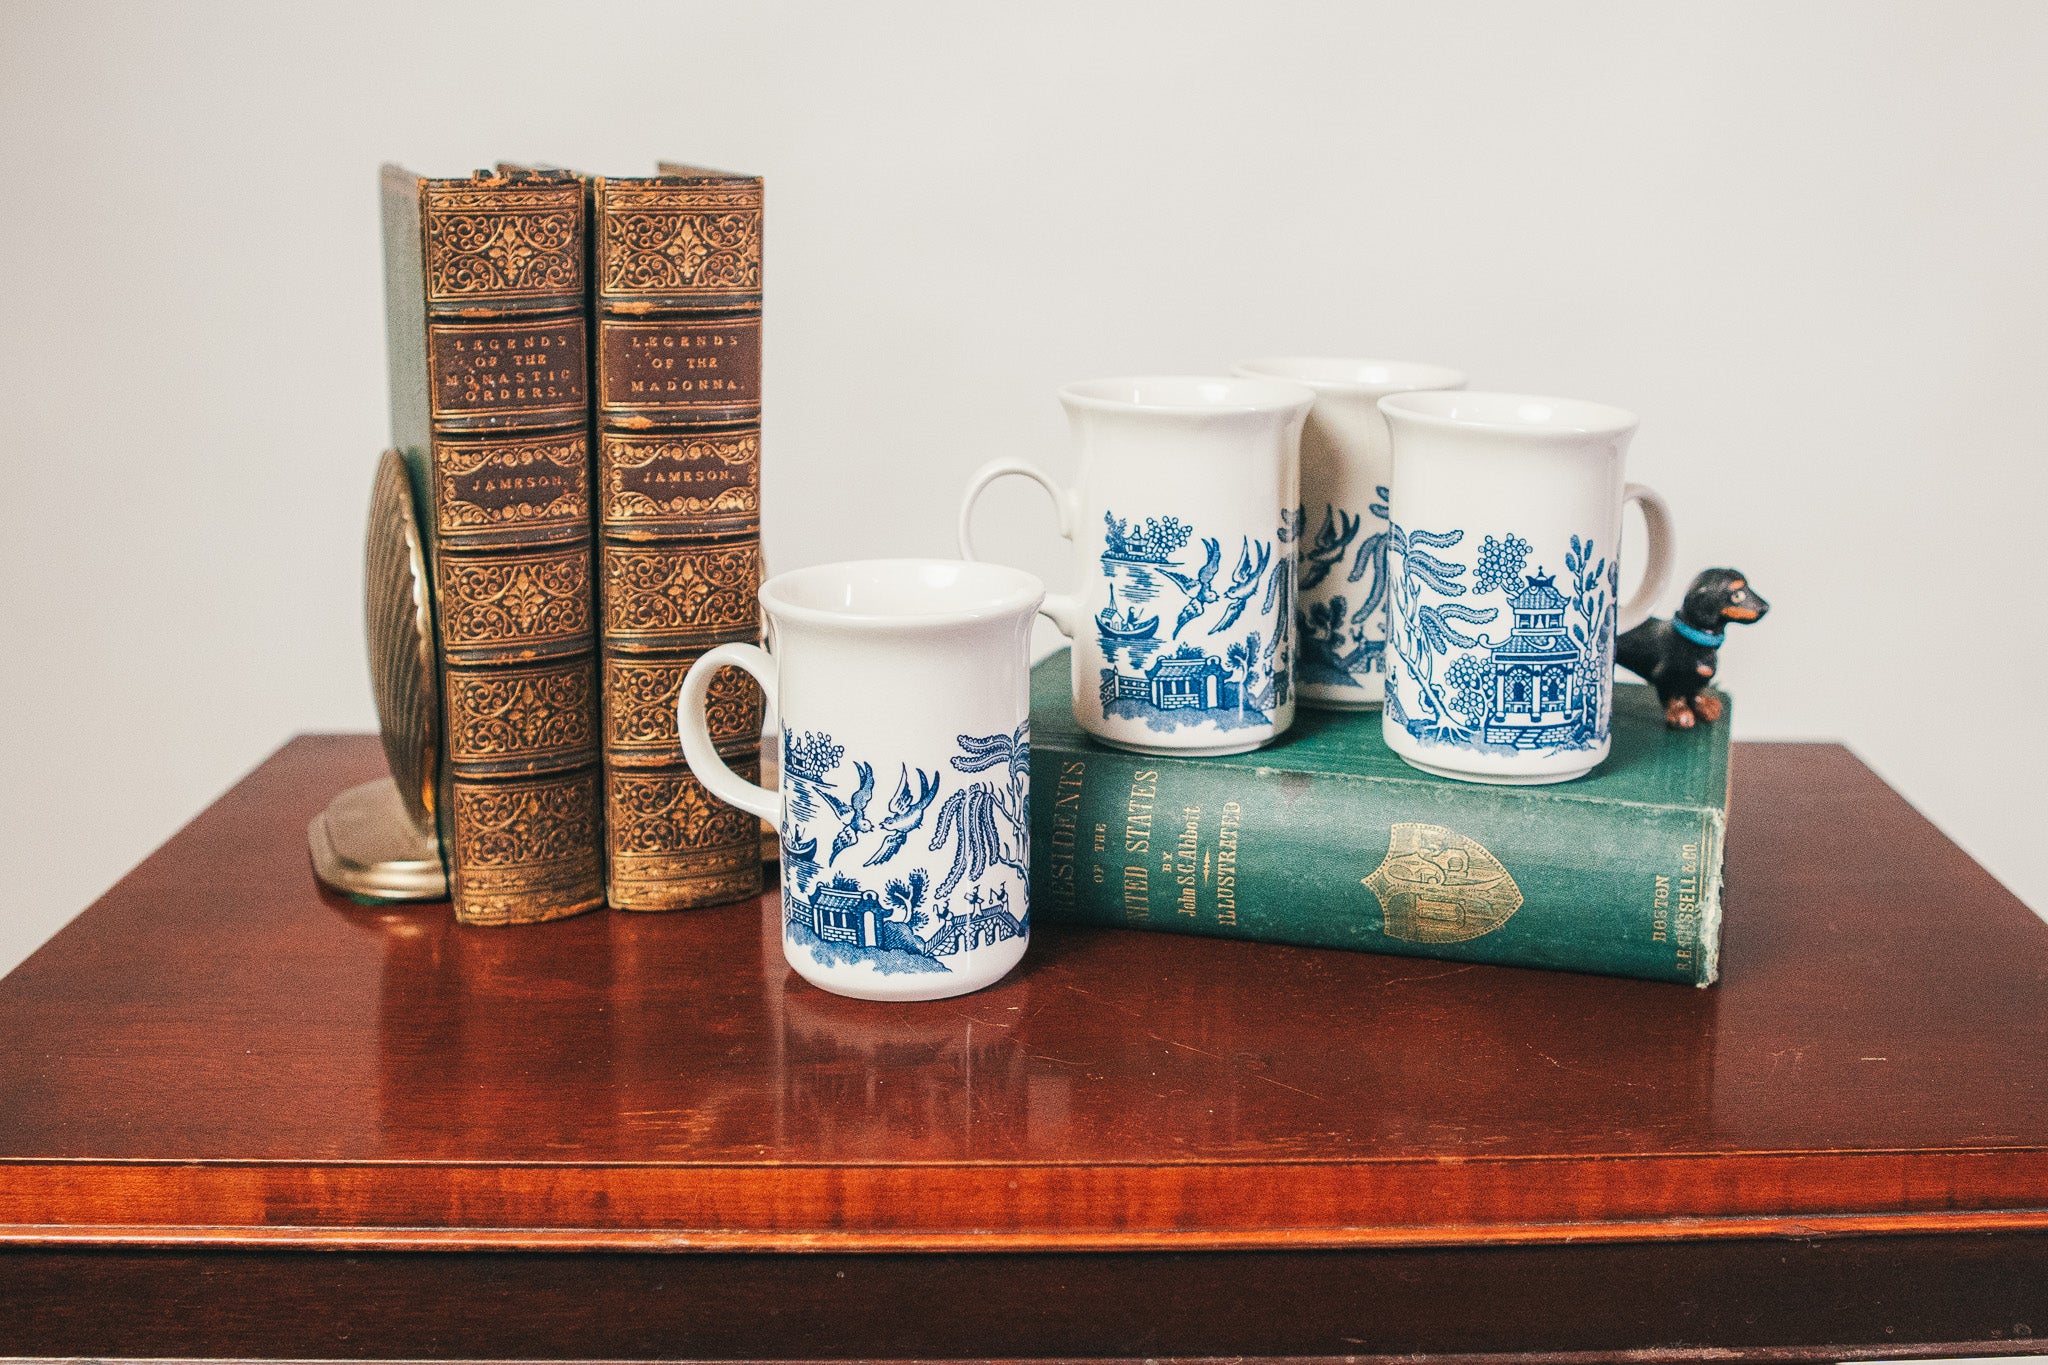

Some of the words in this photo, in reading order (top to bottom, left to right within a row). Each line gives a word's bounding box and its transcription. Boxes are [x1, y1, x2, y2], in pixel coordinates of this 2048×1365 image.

[454, 335, 567, 351] LEGENDS
[631, 335, 739, 348] LEGENDS
[474, 356, 498, 367] OF
[513, 353, 547, 366] THE
[651, 358, 674, 369] OF
[686, 357, 719, 369] THE
[445, 369, 571, 387] MONASTIC
[1125, 769, 1159, 854] STATES
[1094, 823, 1108, 852] THE
[1161, 850, 1174, 873] BY
[1216, 800, 1241, 926] ILLUSTRATED
[1093, 864, 1105, 883] OF
[1177, 887, 1197, 918] John
[1652, 874, 1671, 943] BOSTON
